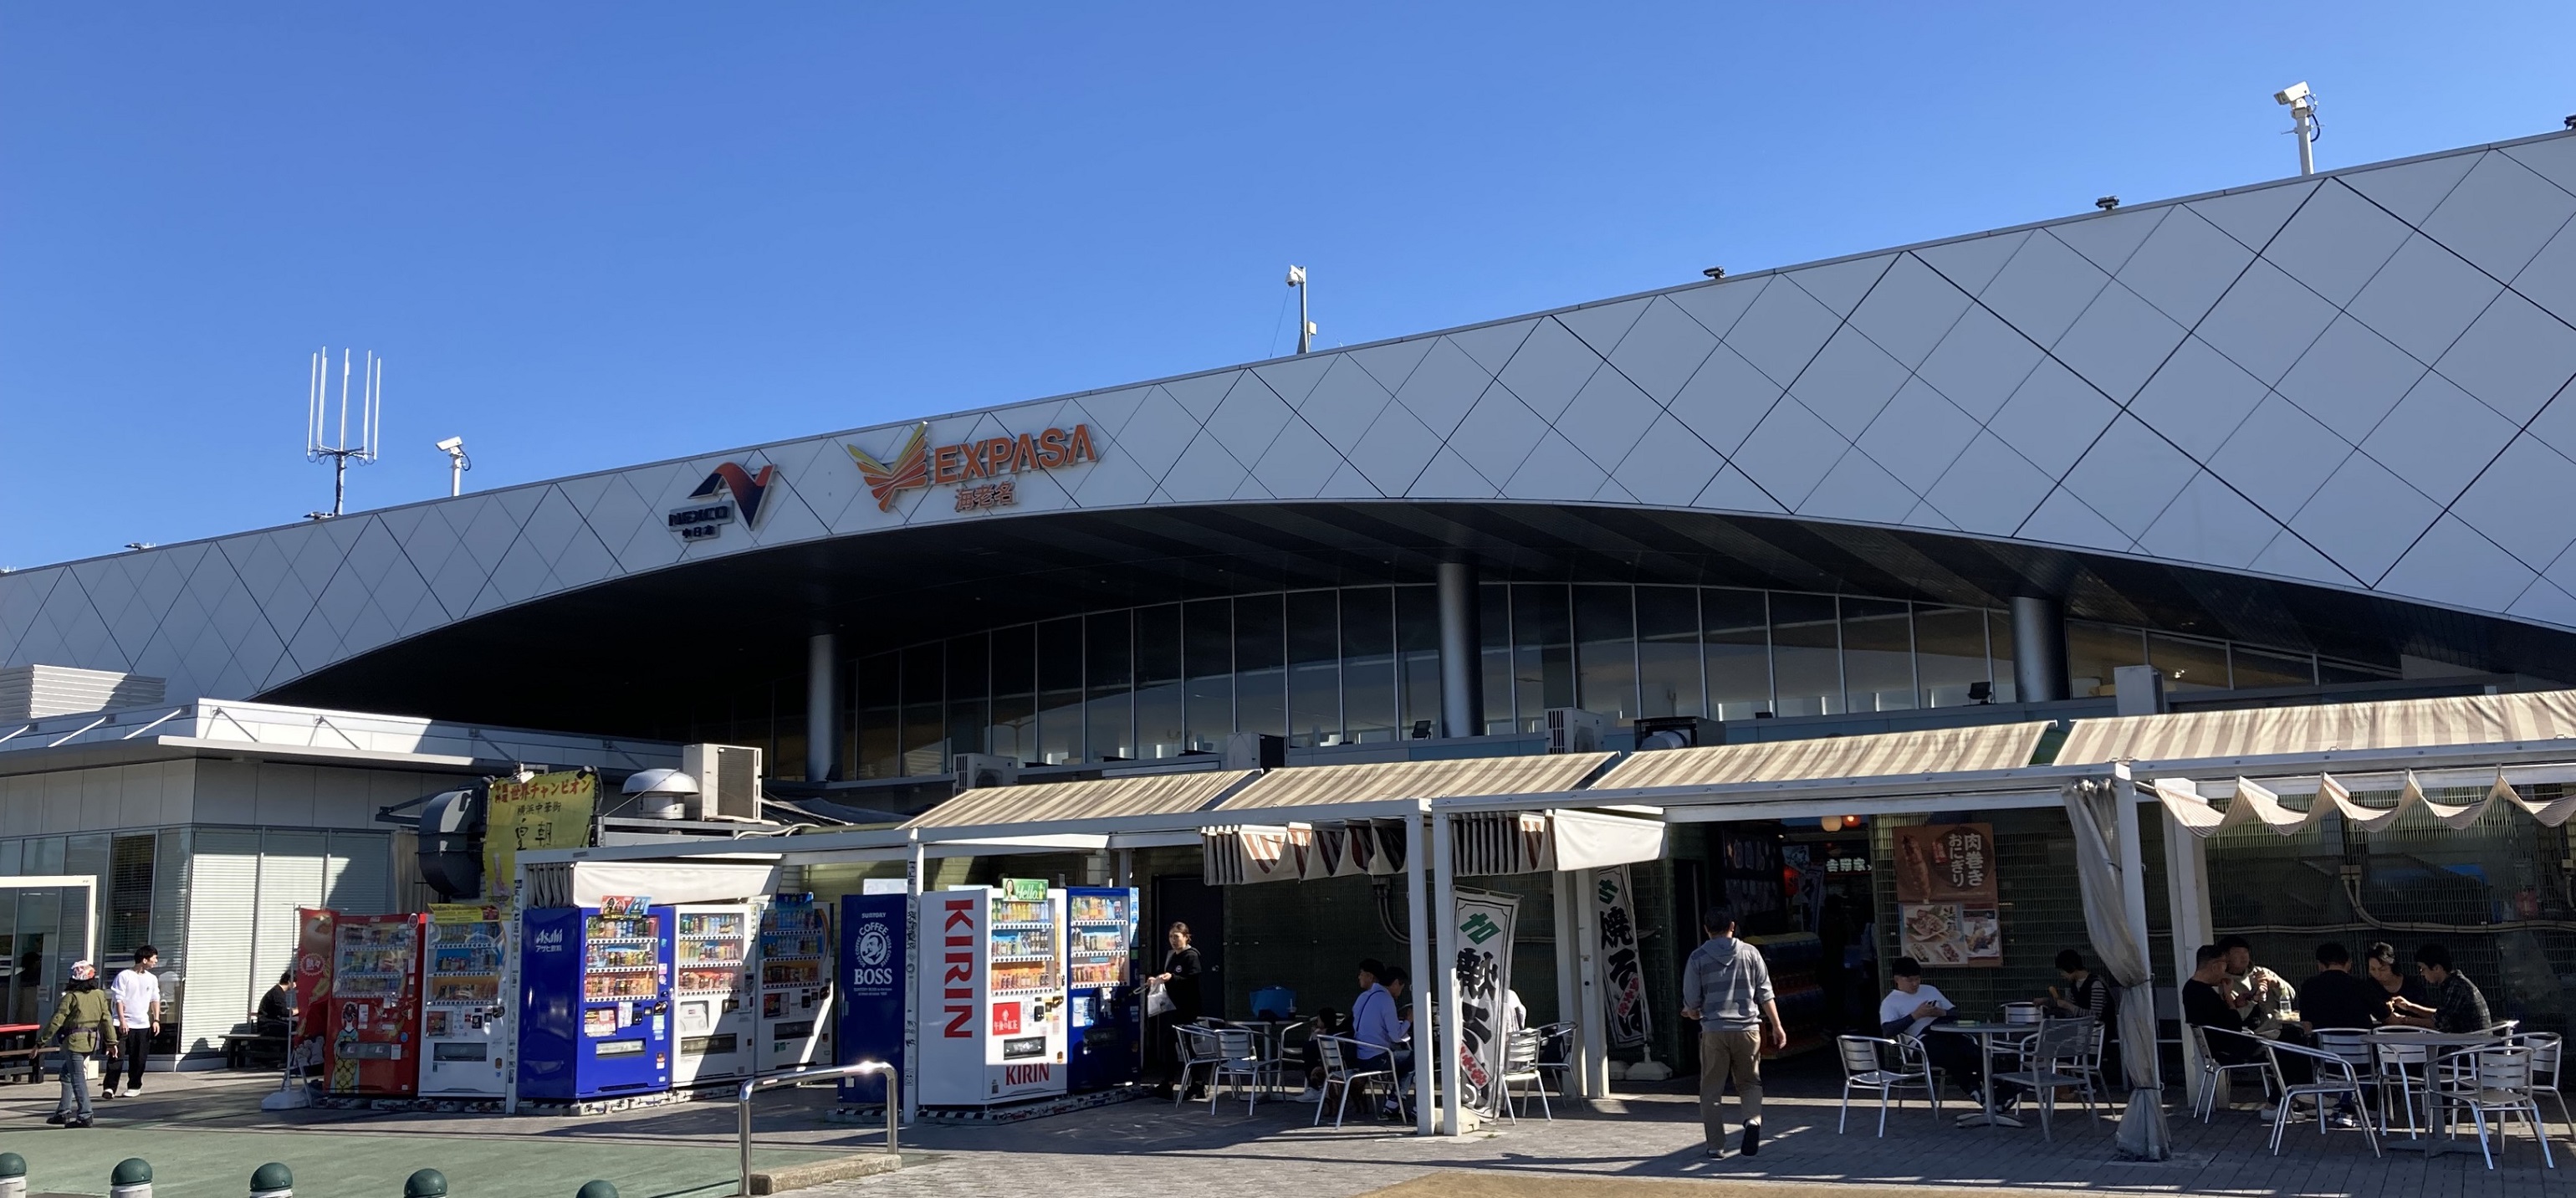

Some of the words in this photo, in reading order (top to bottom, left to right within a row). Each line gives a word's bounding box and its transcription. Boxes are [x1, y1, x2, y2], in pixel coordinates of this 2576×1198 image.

[934, 423, 1097, 484] EXPASA
[955, 481, 1015, 512] 海老名
[510, 779, 591, 801] 世界チャンピオン
[1949, 833, 1965, 888] おにぎり
[1965, 833, 1984, 887] 肉巻き
[535, 928, 563, 945] Asahi
[859, 922, 889, 935] COFFEE
[854, 968, 892, 985] BOSS
[944, 899, 974, 1038] KIRIN
[1005, 1062, 1050, 1086] KIRIN
